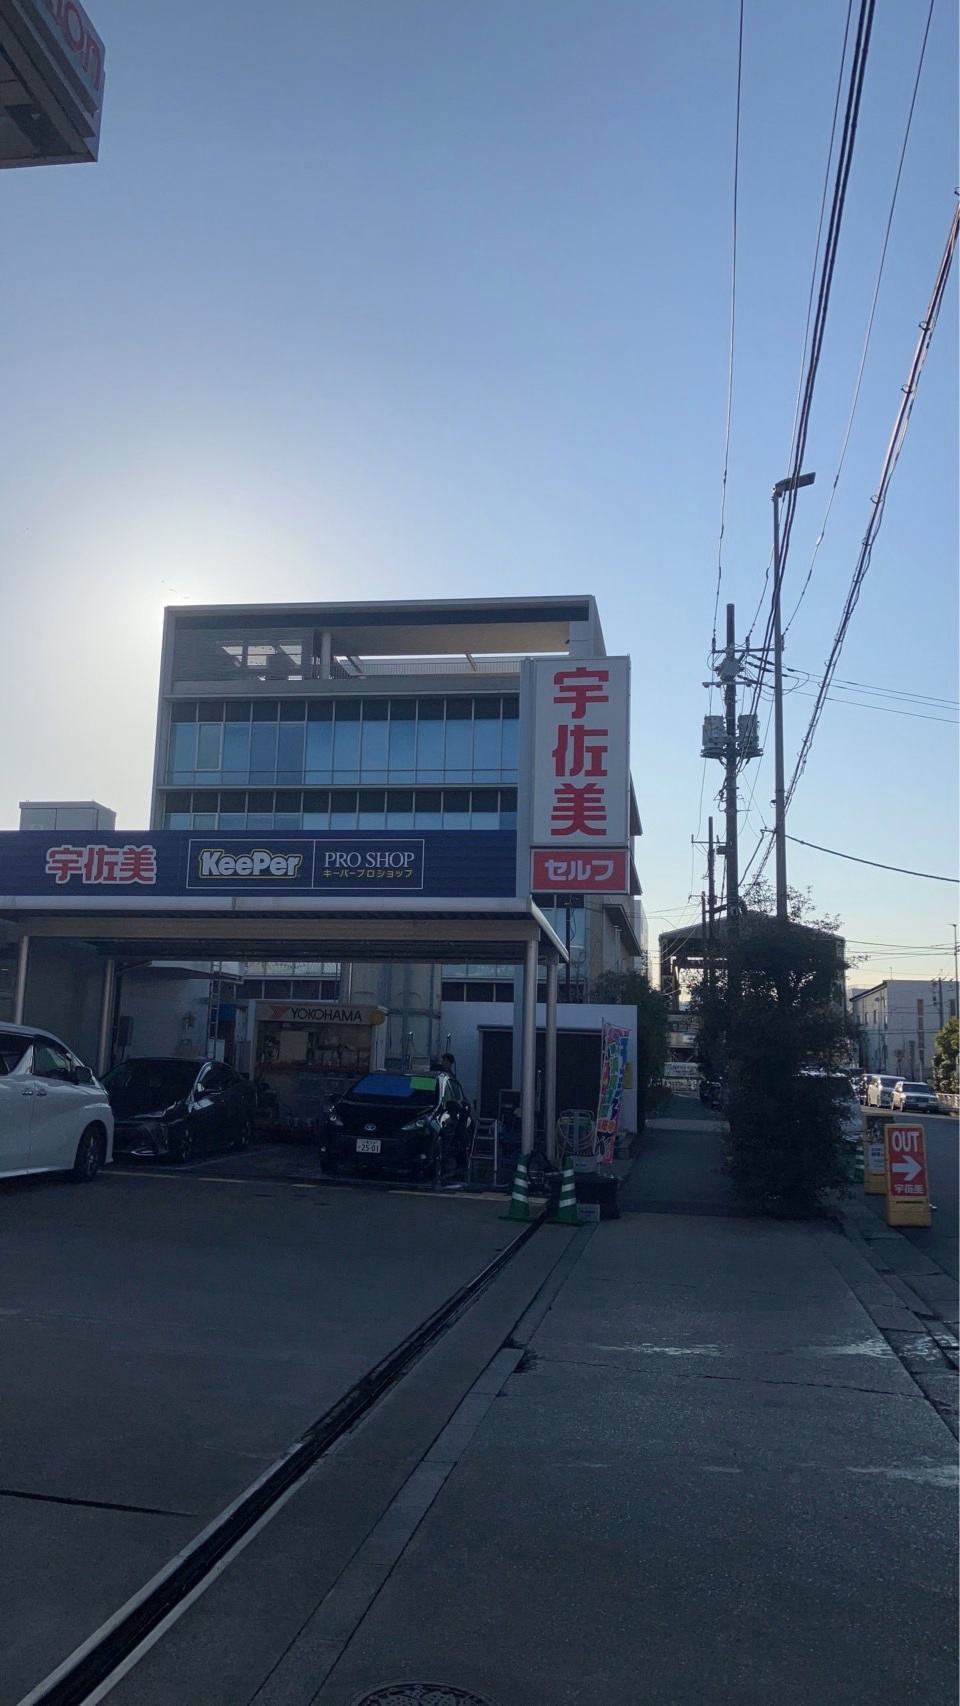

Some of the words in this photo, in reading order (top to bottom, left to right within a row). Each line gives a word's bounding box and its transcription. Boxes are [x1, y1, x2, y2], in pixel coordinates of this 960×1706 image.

[551, 667, 609, 836] 宇佐美
[46, 845, 157, 884] 宇佐美
[200, 849, 302, 878] KeePer
[324, 852, 361, 868] PRO
[365, 852, 415, 868] SHOP
[545, 859, 614, 881] セルフ
[290, 1007, 363, 1022] YOKOHAMA
[892, 1130, 919, 1152] OUT
